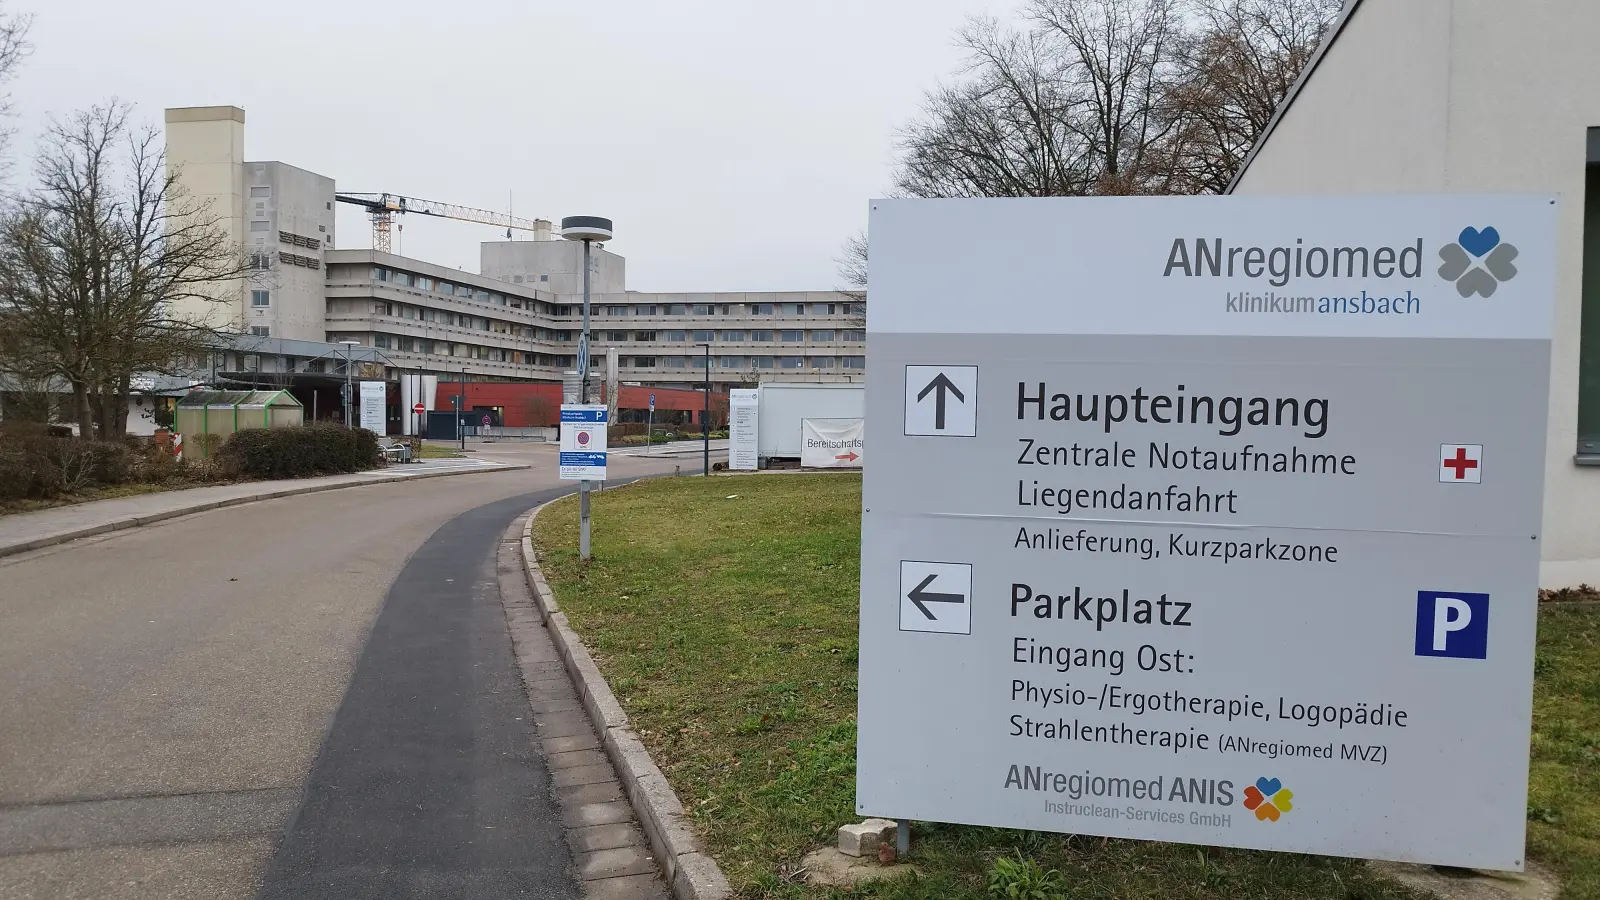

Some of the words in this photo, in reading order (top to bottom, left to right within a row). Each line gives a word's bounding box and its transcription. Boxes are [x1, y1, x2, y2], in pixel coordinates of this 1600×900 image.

[1163, 237, 1423, 287] ANregiomed
[596, 411, 603, 420] P
[1017, 381, 1329, 439] Haupteingang
[1017, 438, 1137, 469] Zentrale
[1148, 441, 1357, 476] Notaufnahme
[1018, 479, 1239, 515] Liegendanfahrt
[1014, 526, 1160, 561] Anlieferung,
[1169, 533, 1339, 565] Kurzparkzone
[1010, 583, 1193, 631] Parkplatz
[1432, 597, 1473, 651] P
[1012, 636, 1125, 677] Eingang
[1136, 643, 1195, 675] Ost:
[1010, 679, 1271, 724] Physio-/Ergotherapie,
[1278, 696, 1409, 730] Logopädie
[1009, 714, 1210, 754] Strahlentherapie
[1218, 734, 1334, 760] (ANregiomed
[1340, 742, 1388, 766] MVZ)
[1004, 764, 1163, 802] ANregiomed
[1168, 776, 1235, 807] ANIS
[1044, 800, 1185, 826] Instruclean-Services
[1188, 811, 1233, 829] GmbH
